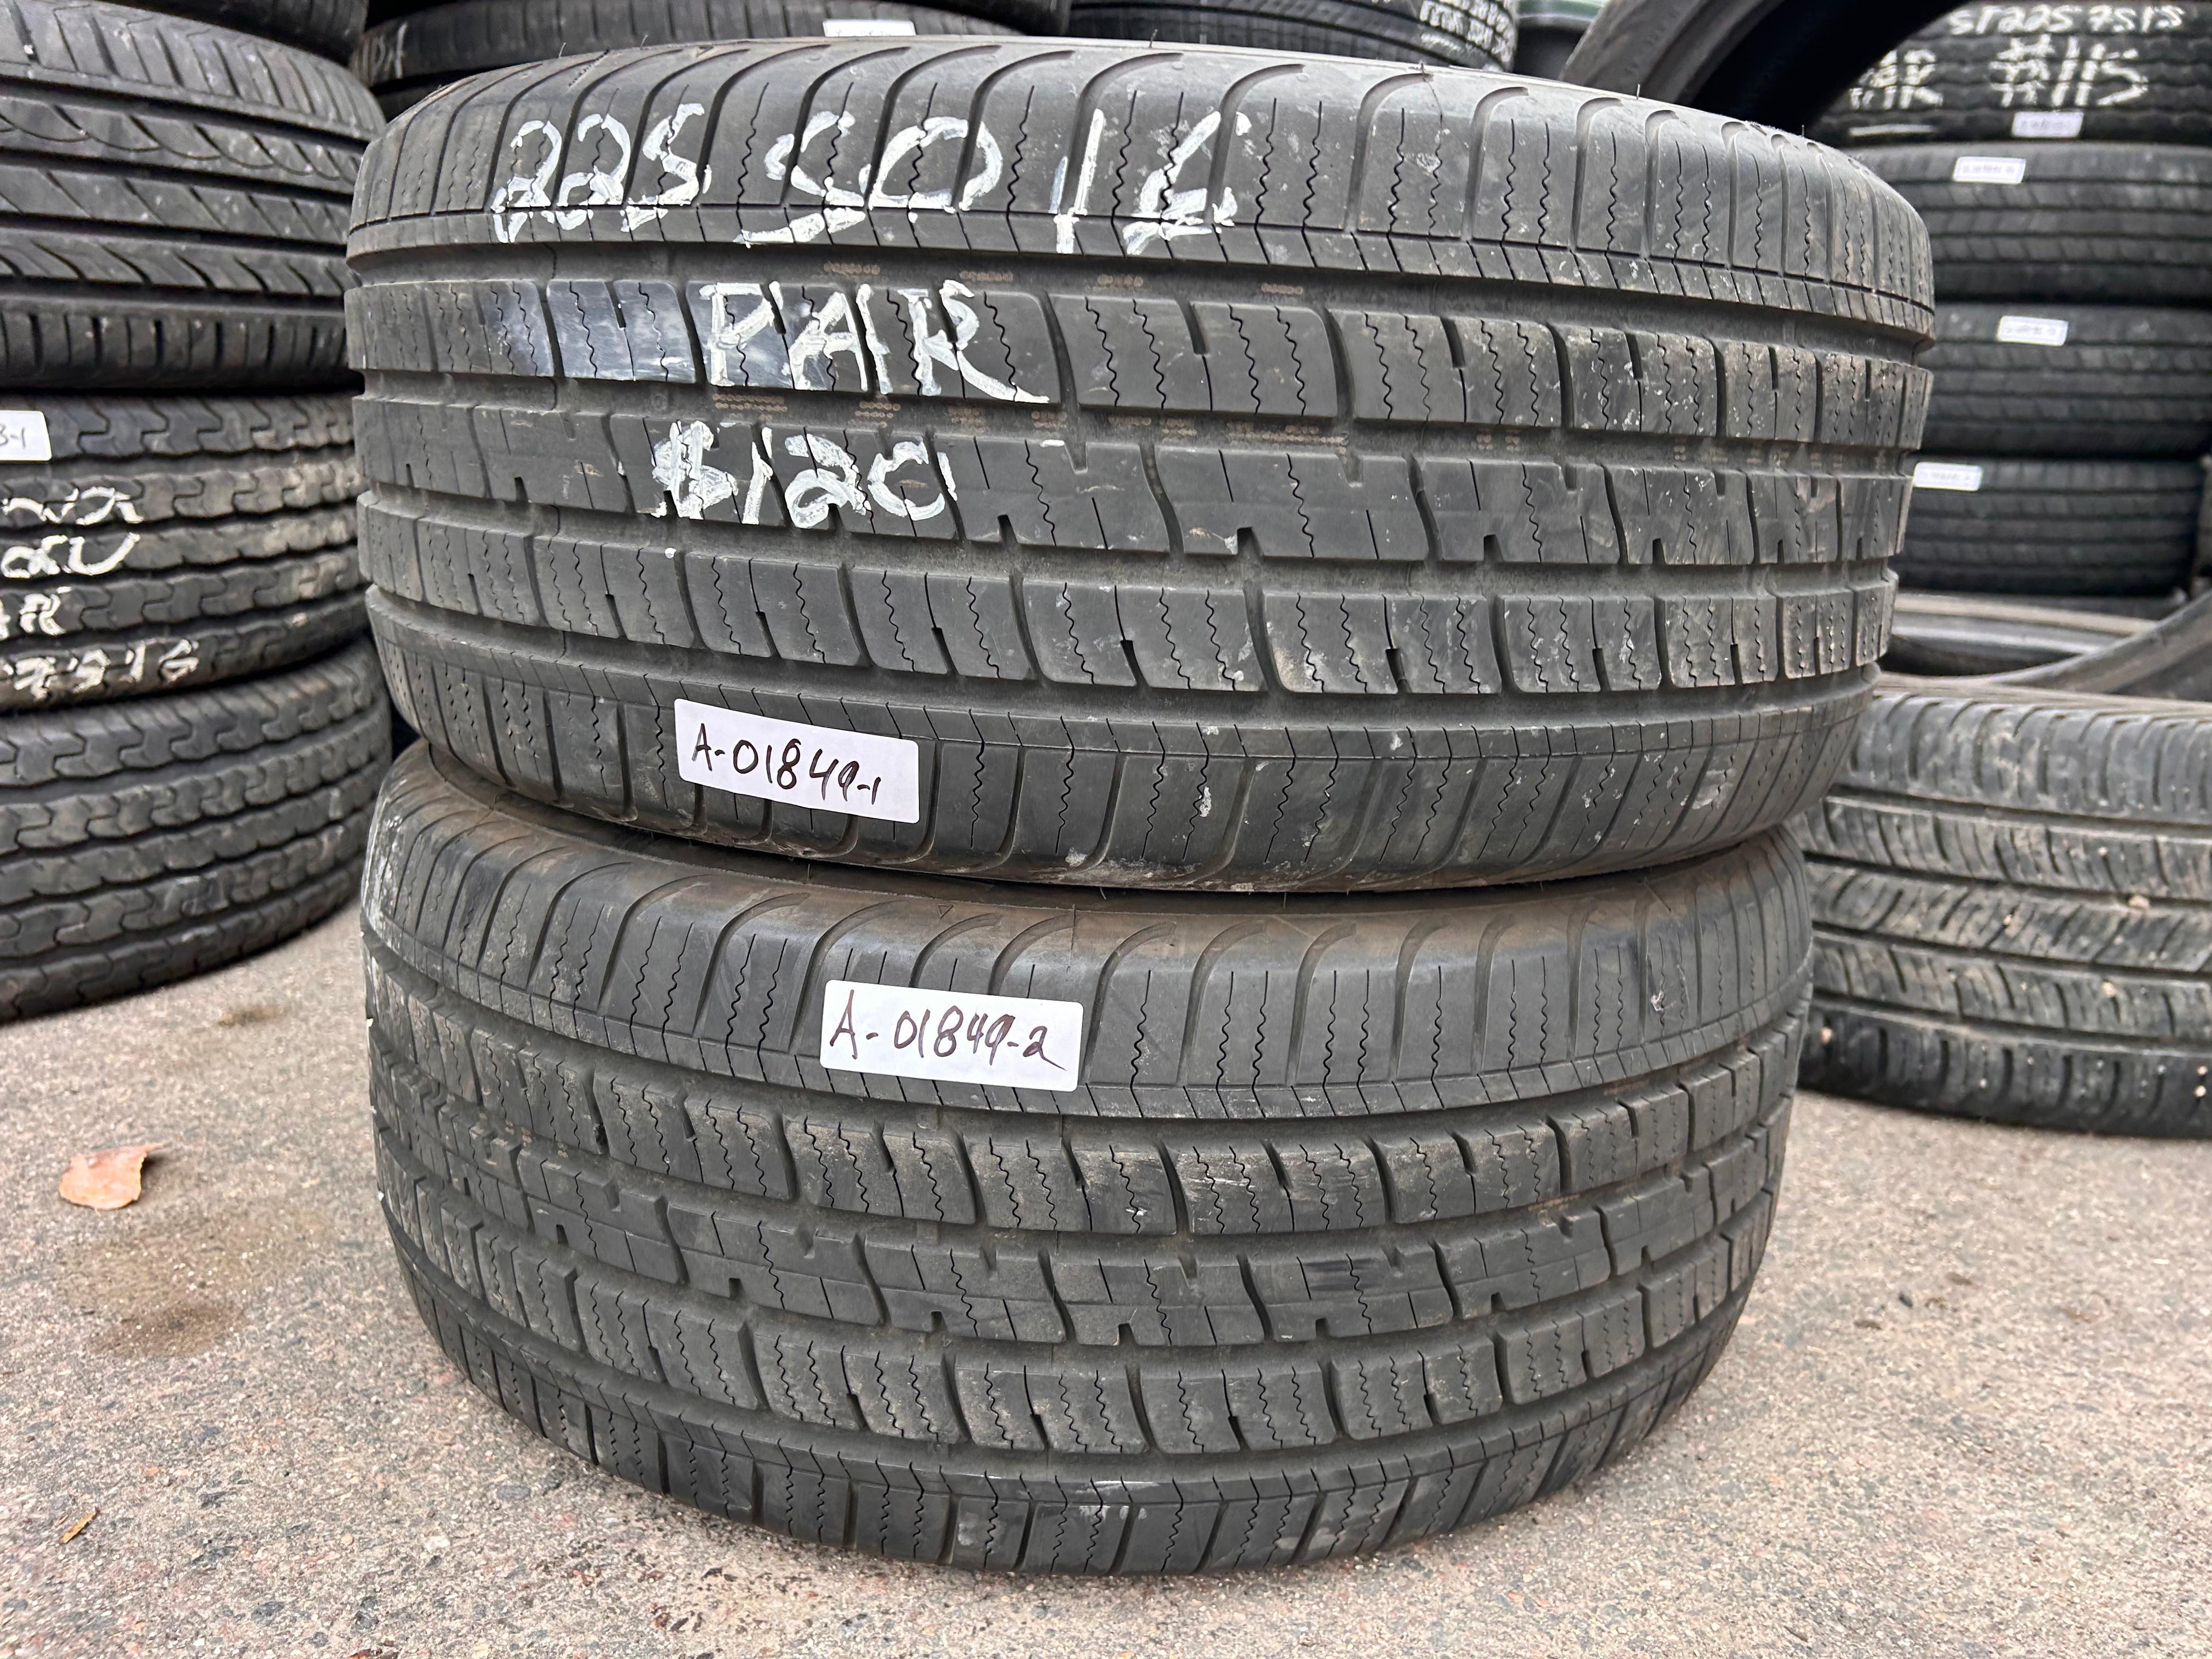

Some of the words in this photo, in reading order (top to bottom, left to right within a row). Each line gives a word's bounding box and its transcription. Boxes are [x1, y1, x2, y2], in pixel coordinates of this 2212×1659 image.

[493, 102, 713, 243] 225
[699, 279, 1051, 405] PAR
[651, 420, 957, 527] $120
[691, 722, 881, 805] A-01849-1
[830, 989, 1068, 1072] A-01849-2
